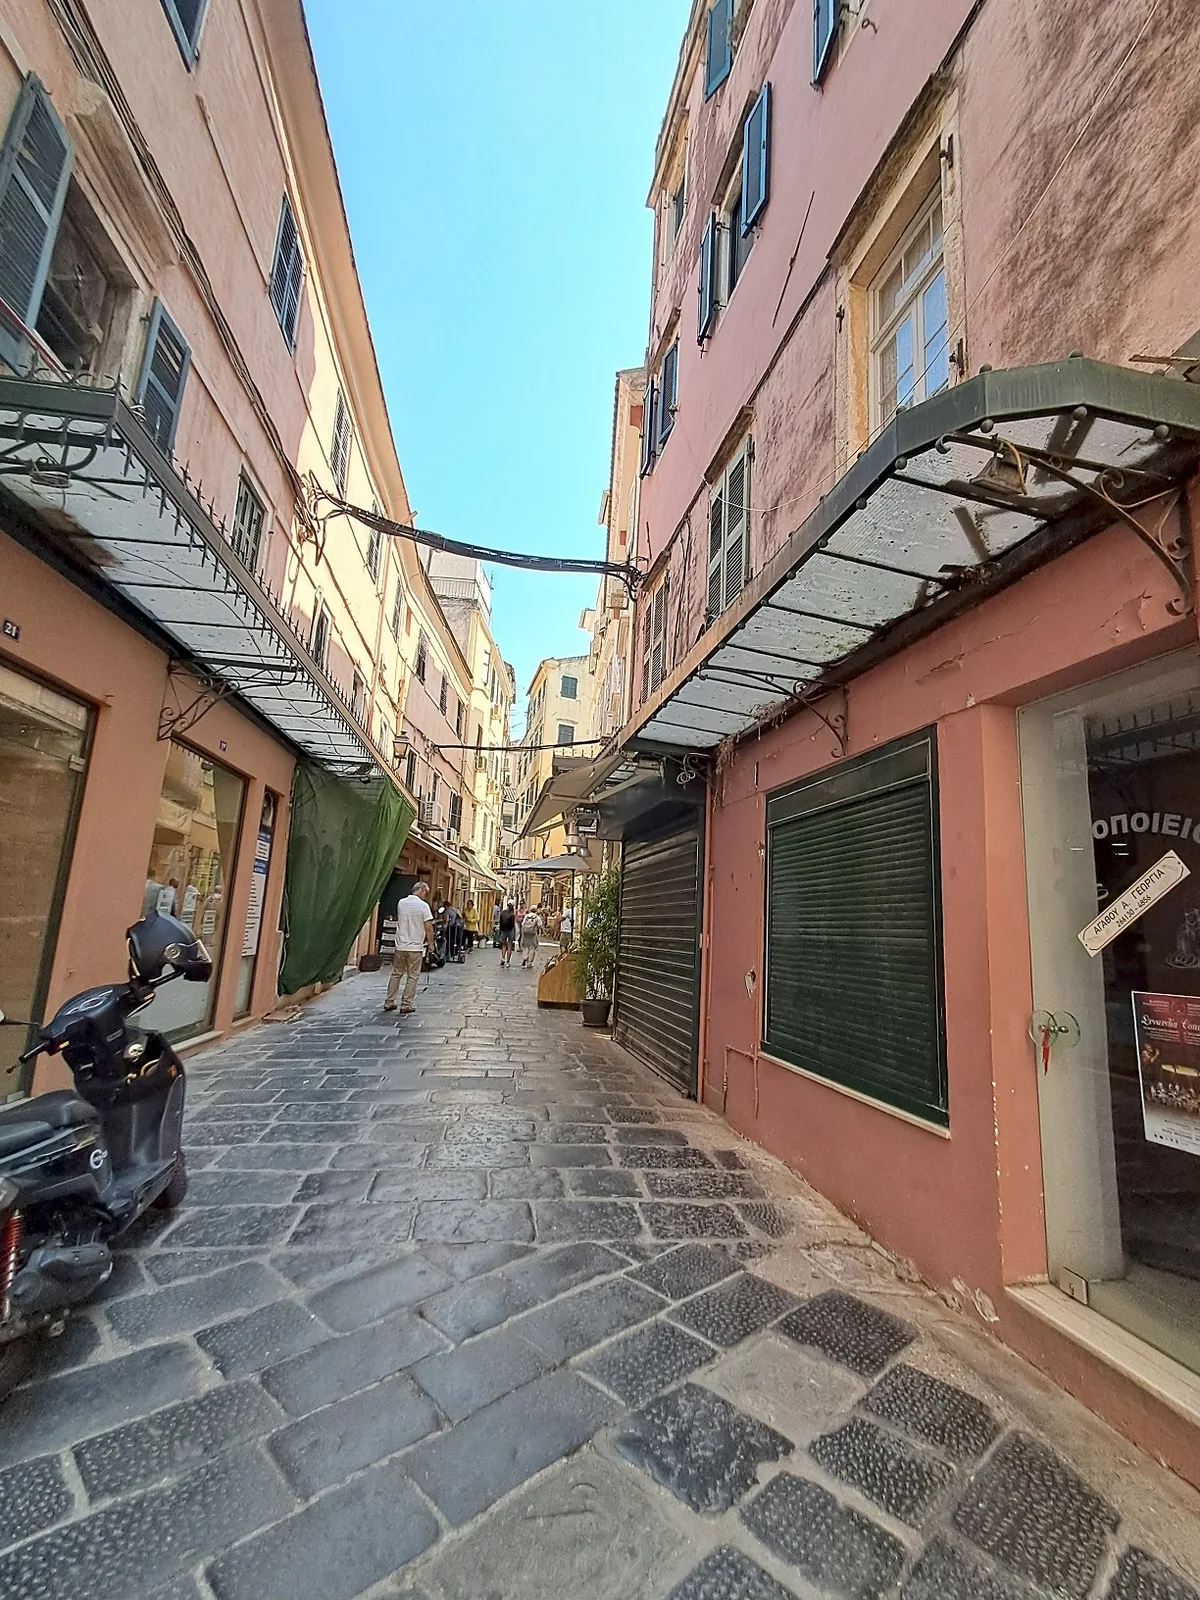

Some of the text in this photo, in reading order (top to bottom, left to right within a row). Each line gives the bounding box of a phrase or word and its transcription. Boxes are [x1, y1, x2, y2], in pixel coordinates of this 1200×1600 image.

[4, 622, 17, 637] 21
[1093, 906, 1120, 935] ΑΓΑΘΟΥ
[1122, 901, 1131, 909] Α.
[1131, 868, 1165, 900] ΓΕΩΡΓΙΑ
